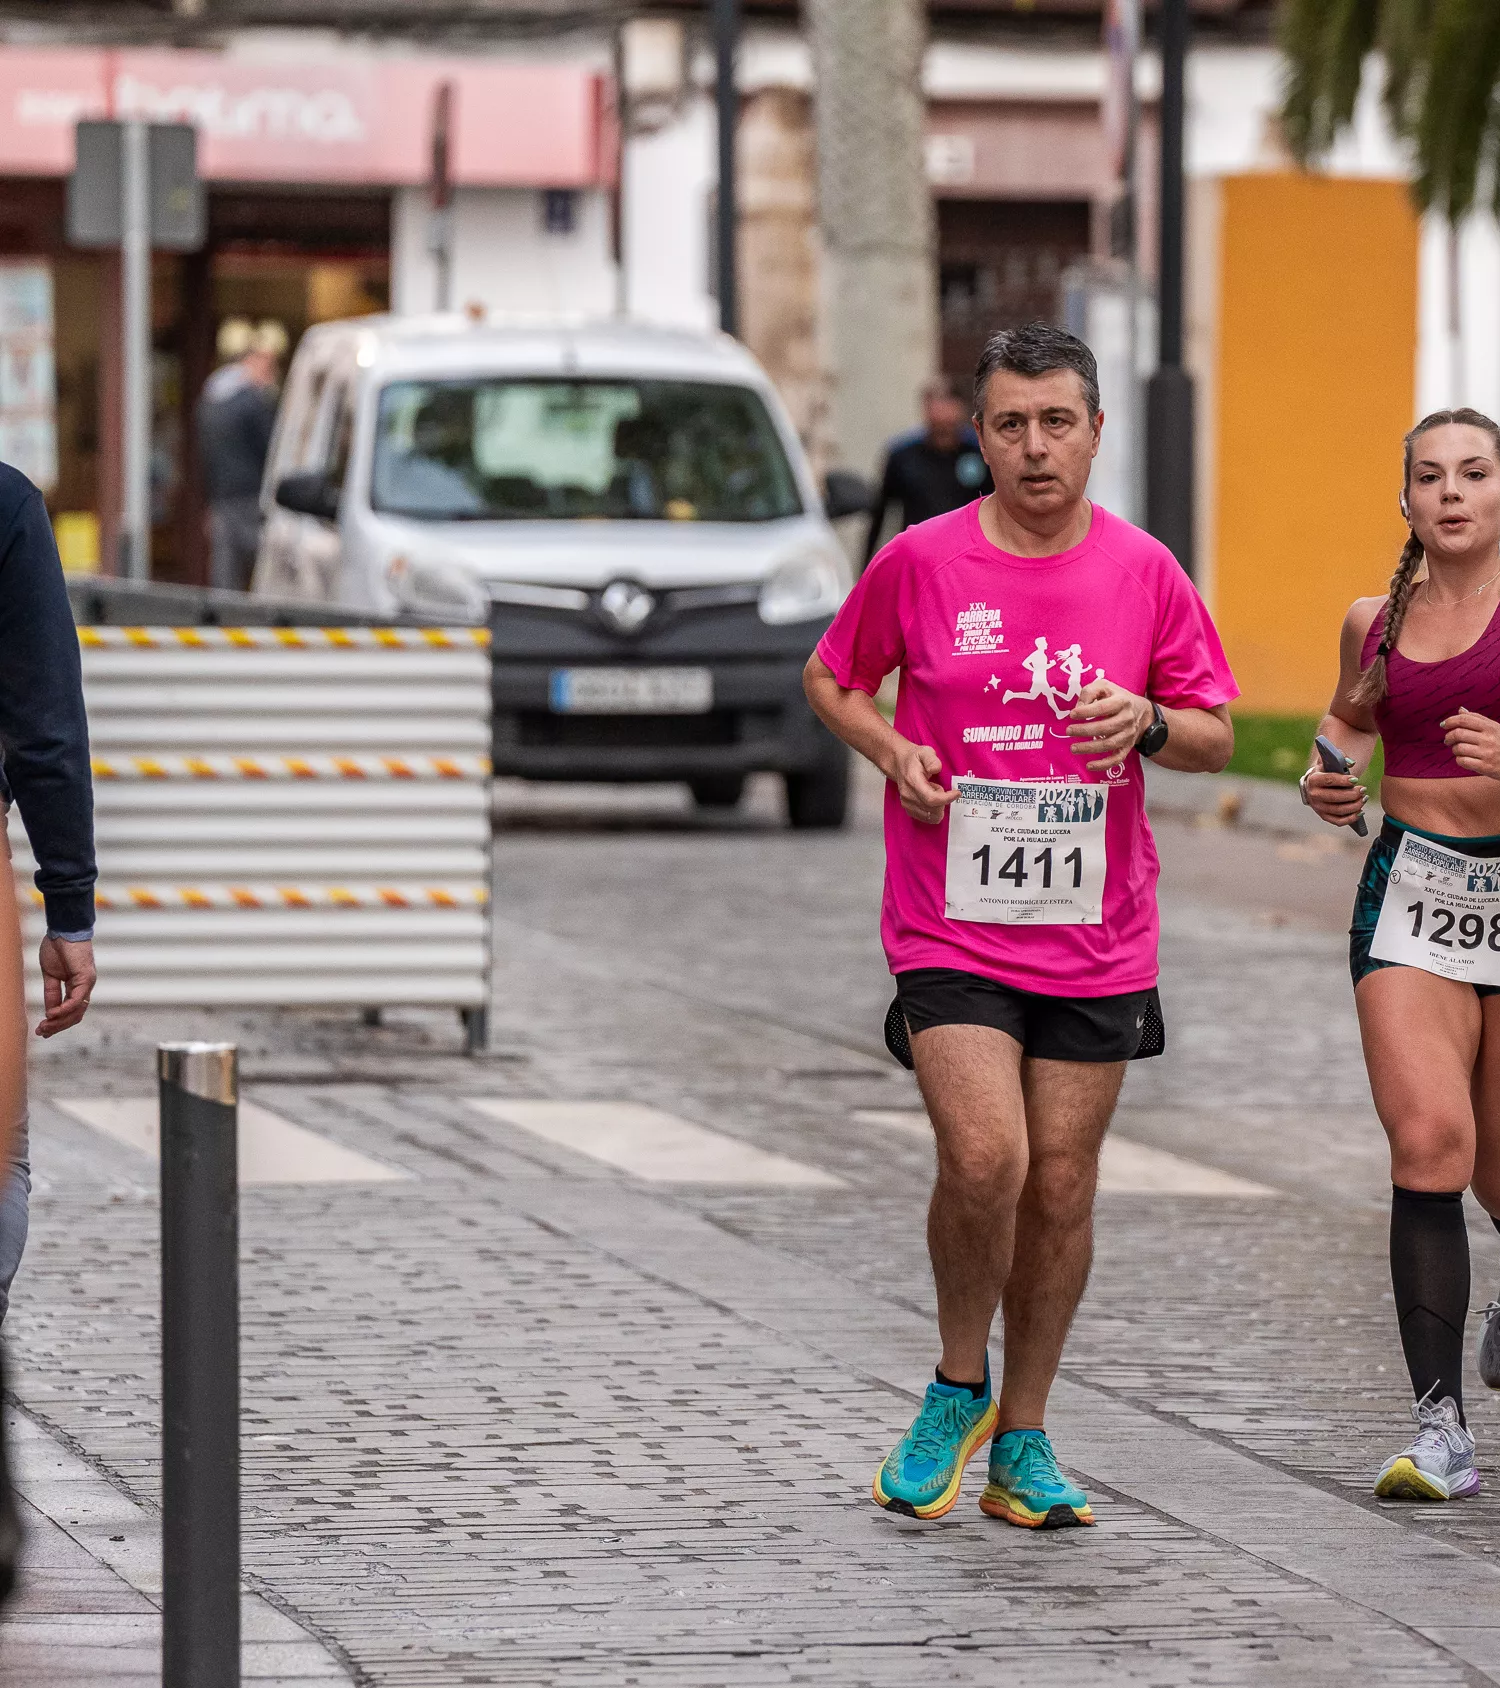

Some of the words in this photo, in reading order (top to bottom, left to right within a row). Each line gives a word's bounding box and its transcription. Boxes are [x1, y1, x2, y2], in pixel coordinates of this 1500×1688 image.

[969, 602, 987, 611] XXV
[957, 609, 1001, 624] CARRERA
[955, 621, 1003, 631] POPULAR
[954, 635, 1004, 646] LUCENA
[962, 725, 1022, 744] SUMANDO
[1023, 724, 1045, 739] KM
[992, 742, 1005, 752] POR
[1005, 742, 1014, 751] LA
[1014, 740, 1044, 750] IGUALDAD
[957, 783, 987, 793] CIRCUITO
[988, 786, 1027, 796] PROVINCIAL
[960, 790, 994, 801] ARRERAS
[995, 794, 1037, 804] POPULARES
[1038, 788, 1076, 805] 2024
[1404, 846, 1432, 864] CARRERAS
[1431, 856, 1467, 874] POPULARES
[1428, 848, 1459, 865] PROVINCIAL
[972, 844, 1082, 889] 1411
[1423, 886, 1437, 894] XXV
[1447, 893, 1468, 902] CIUDAD
[979, 897, 1009, 905] ANTONIO
[1434, 897, 1446, 905] POR
[1455, 902, 1485, 910] IGUALDAD
[1429, 951, 1447, 961] IRENE
